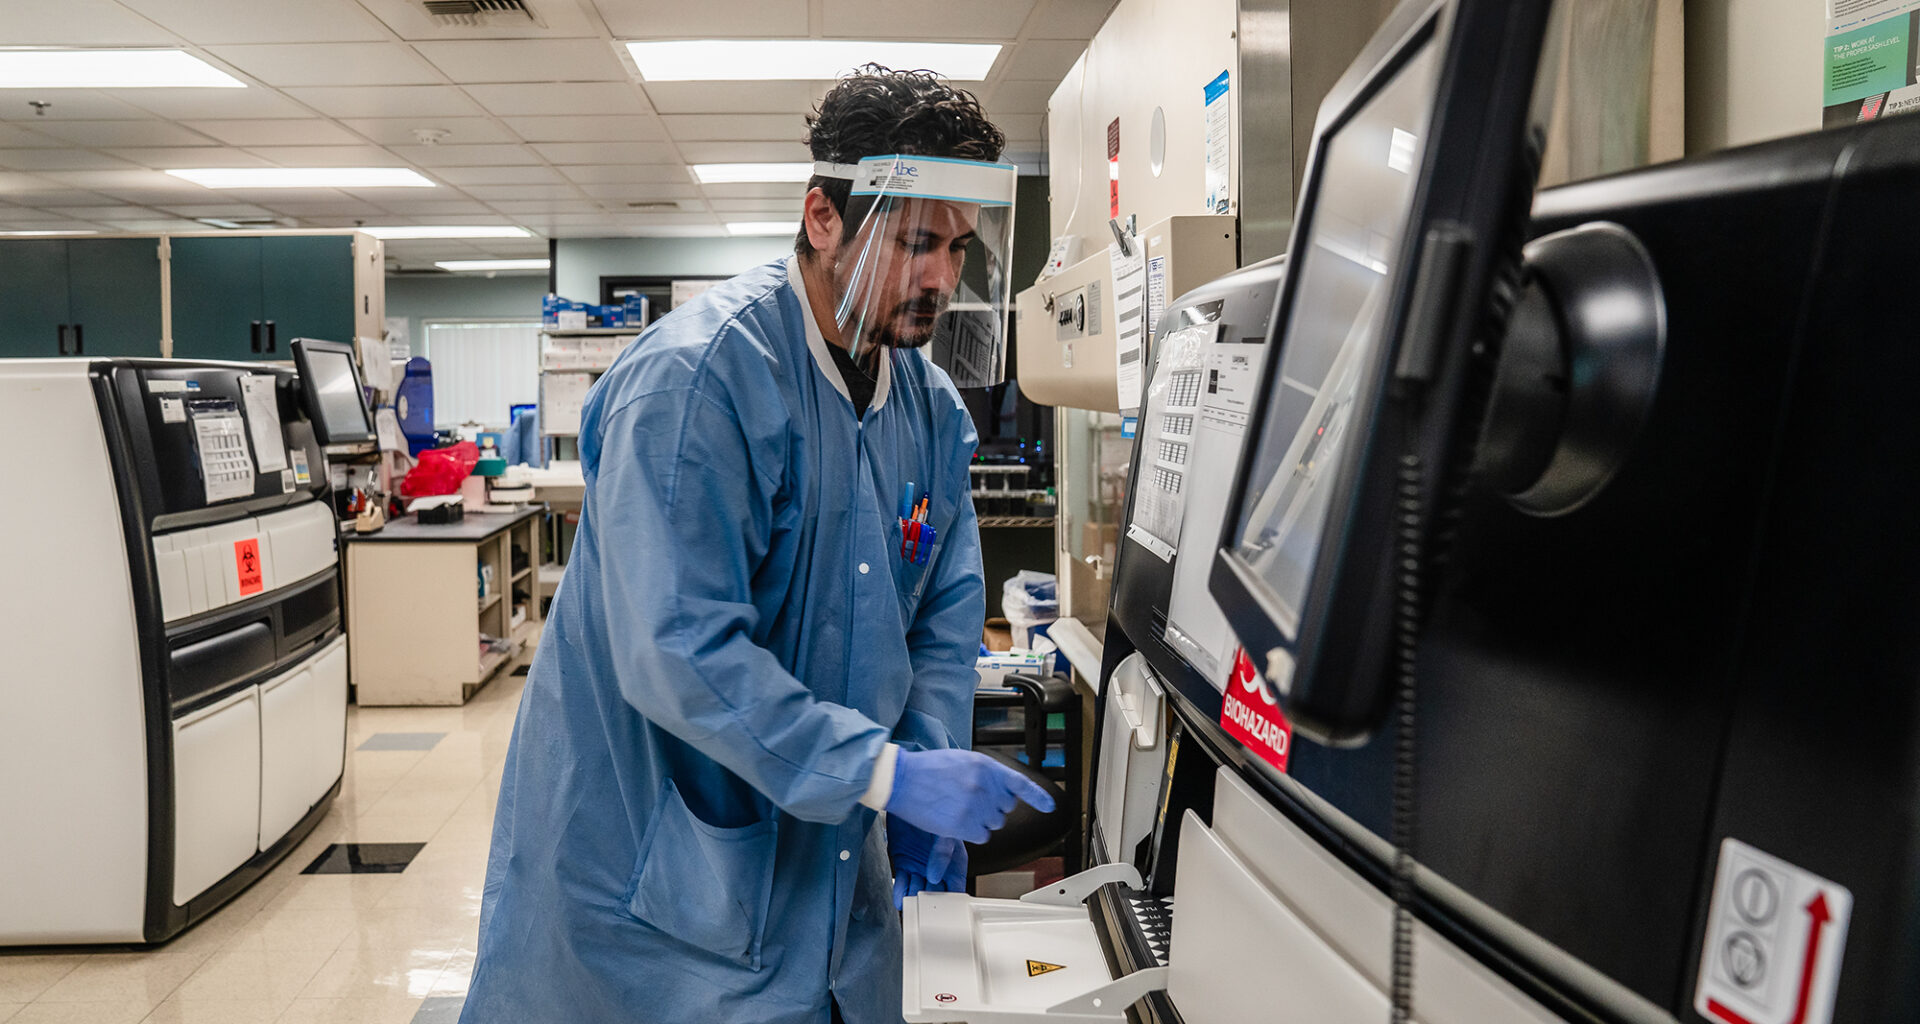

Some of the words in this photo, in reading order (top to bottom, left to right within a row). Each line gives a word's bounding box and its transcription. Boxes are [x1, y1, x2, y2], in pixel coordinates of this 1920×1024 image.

[1851, 39, 1867, 48] WORK
[1868, 35, 1876, 44] AT
[1833, 52, 1845, 60] THE
[1846, 45, 1868, 57] PROPER
[1889, 102, 1898, 110] TIP
[1224, 693, 1288, 756] BIOHAZARD
